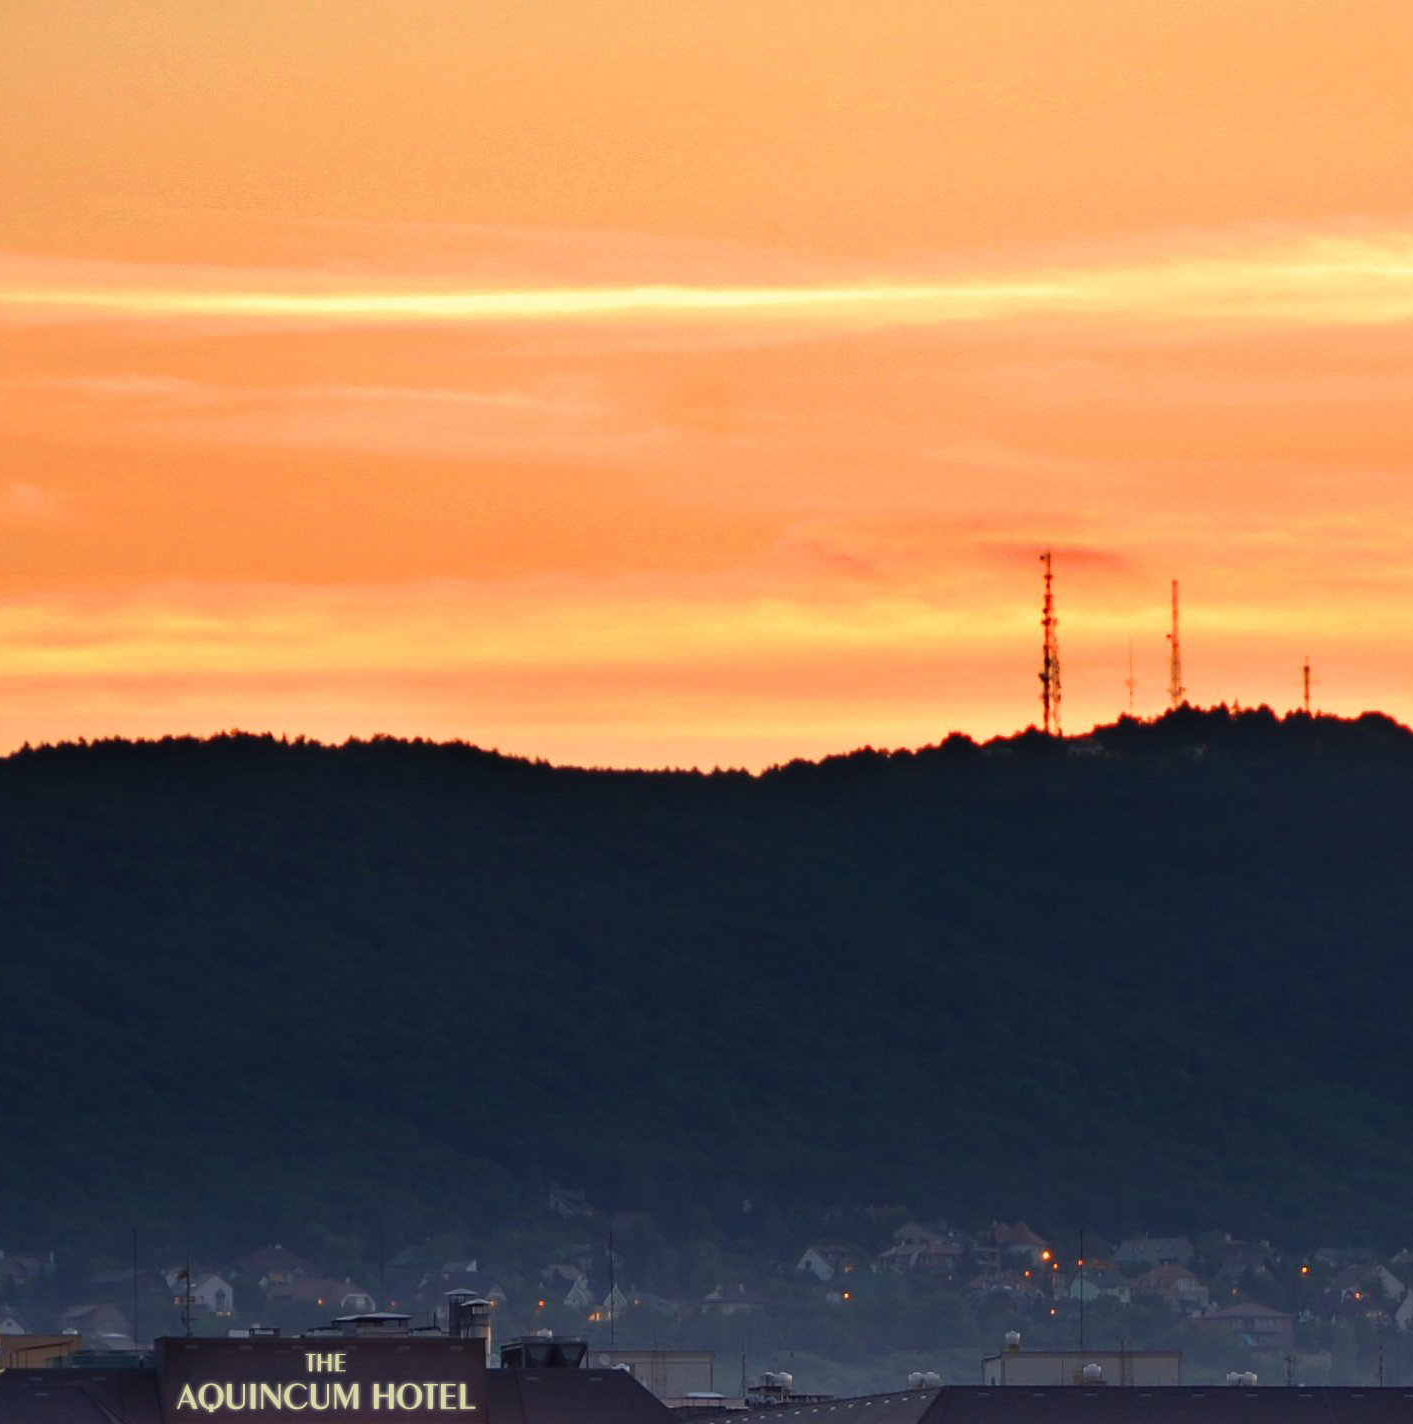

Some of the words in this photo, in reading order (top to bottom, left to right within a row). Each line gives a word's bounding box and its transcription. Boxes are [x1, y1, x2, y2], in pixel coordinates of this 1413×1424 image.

[305, 1353, 347, 1372] THE
[176, 1383, 360, 1412] AQUINCUM
[373, 1383, 476, 1410] HOTEL
